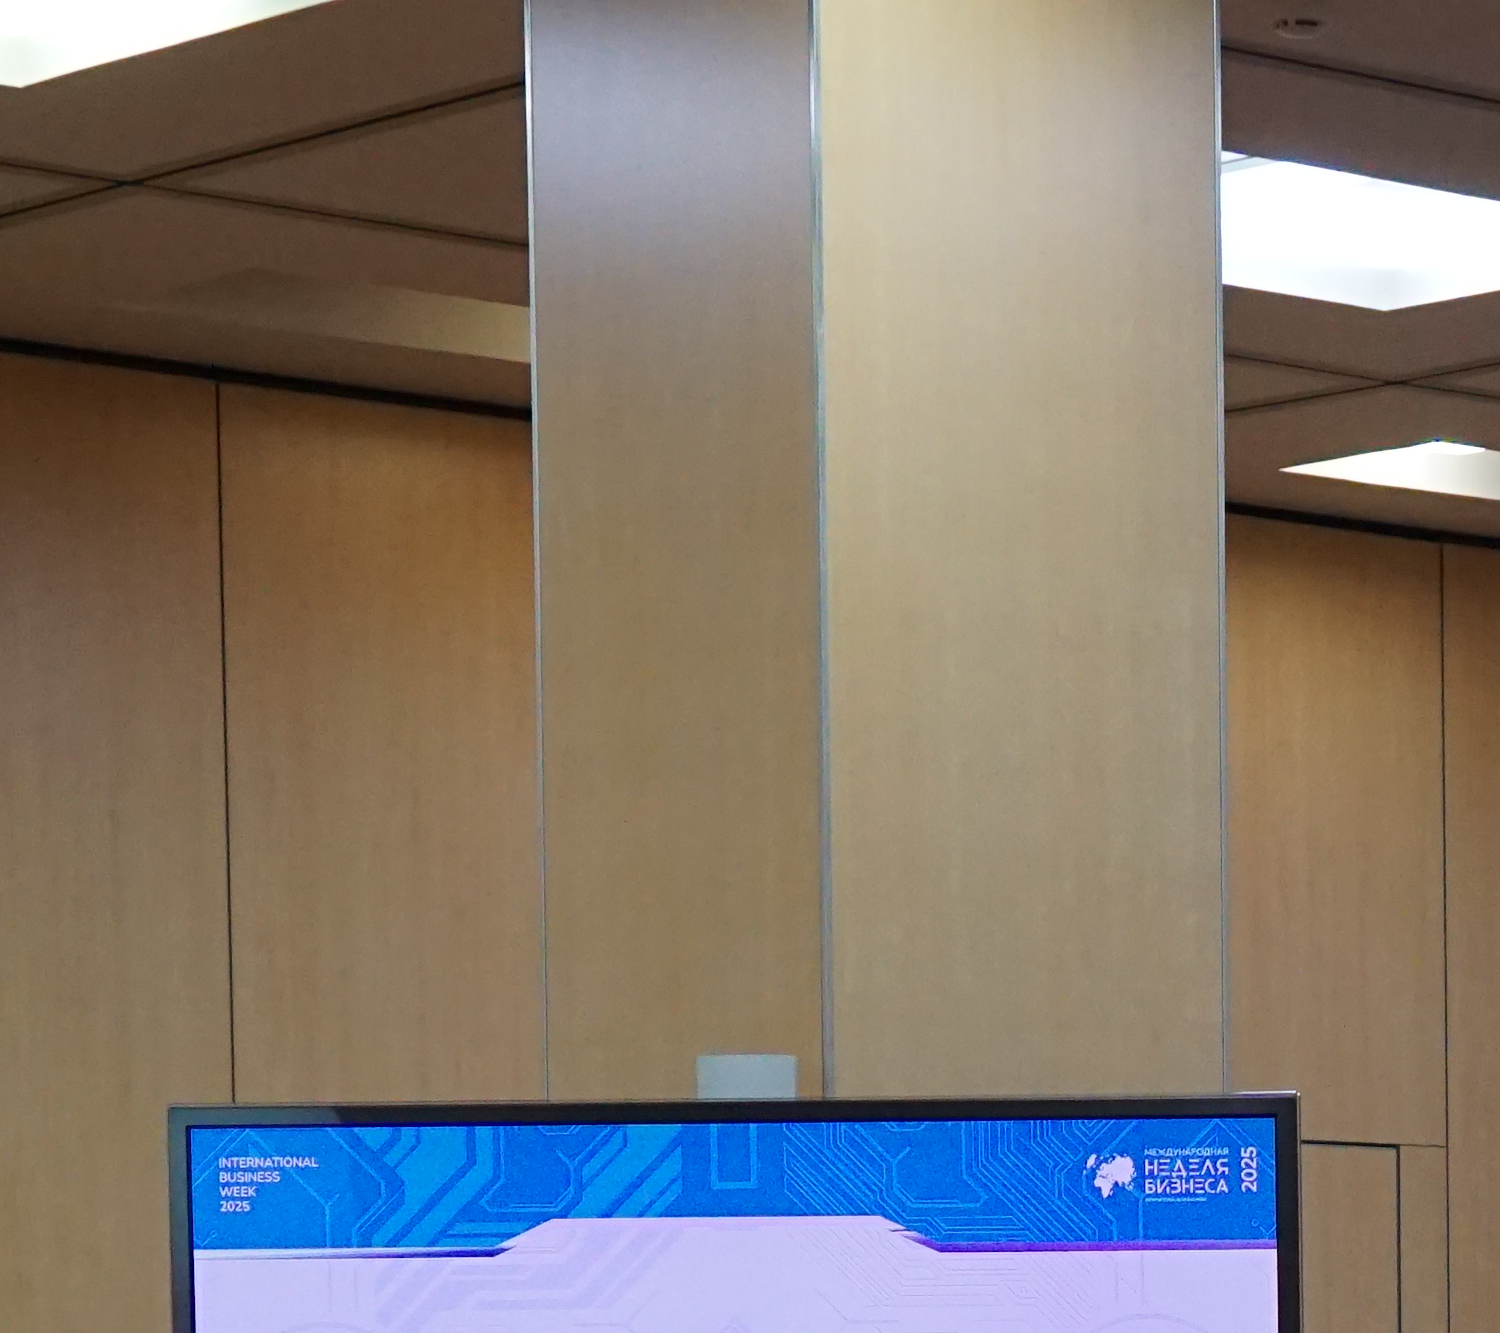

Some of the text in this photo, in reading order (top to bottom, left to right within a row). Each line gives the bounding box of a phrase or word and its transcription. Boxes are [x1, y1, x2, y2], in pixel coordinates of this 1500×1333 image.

[218, 1157, 319, 1169] INTERNATIONAL
[1144, 1158, 1230, 1178] НЕДЕЛЯ
[1241, 1146, 1258, 1193] 2025
[218, 1171, 281, 1183] BUSINESS
[219, 1186, 257, 1198] WEEK
[1144, 1178, 1230, 1194] БИЗНЕСА
[219, 1200, 251, 1213] 2025
